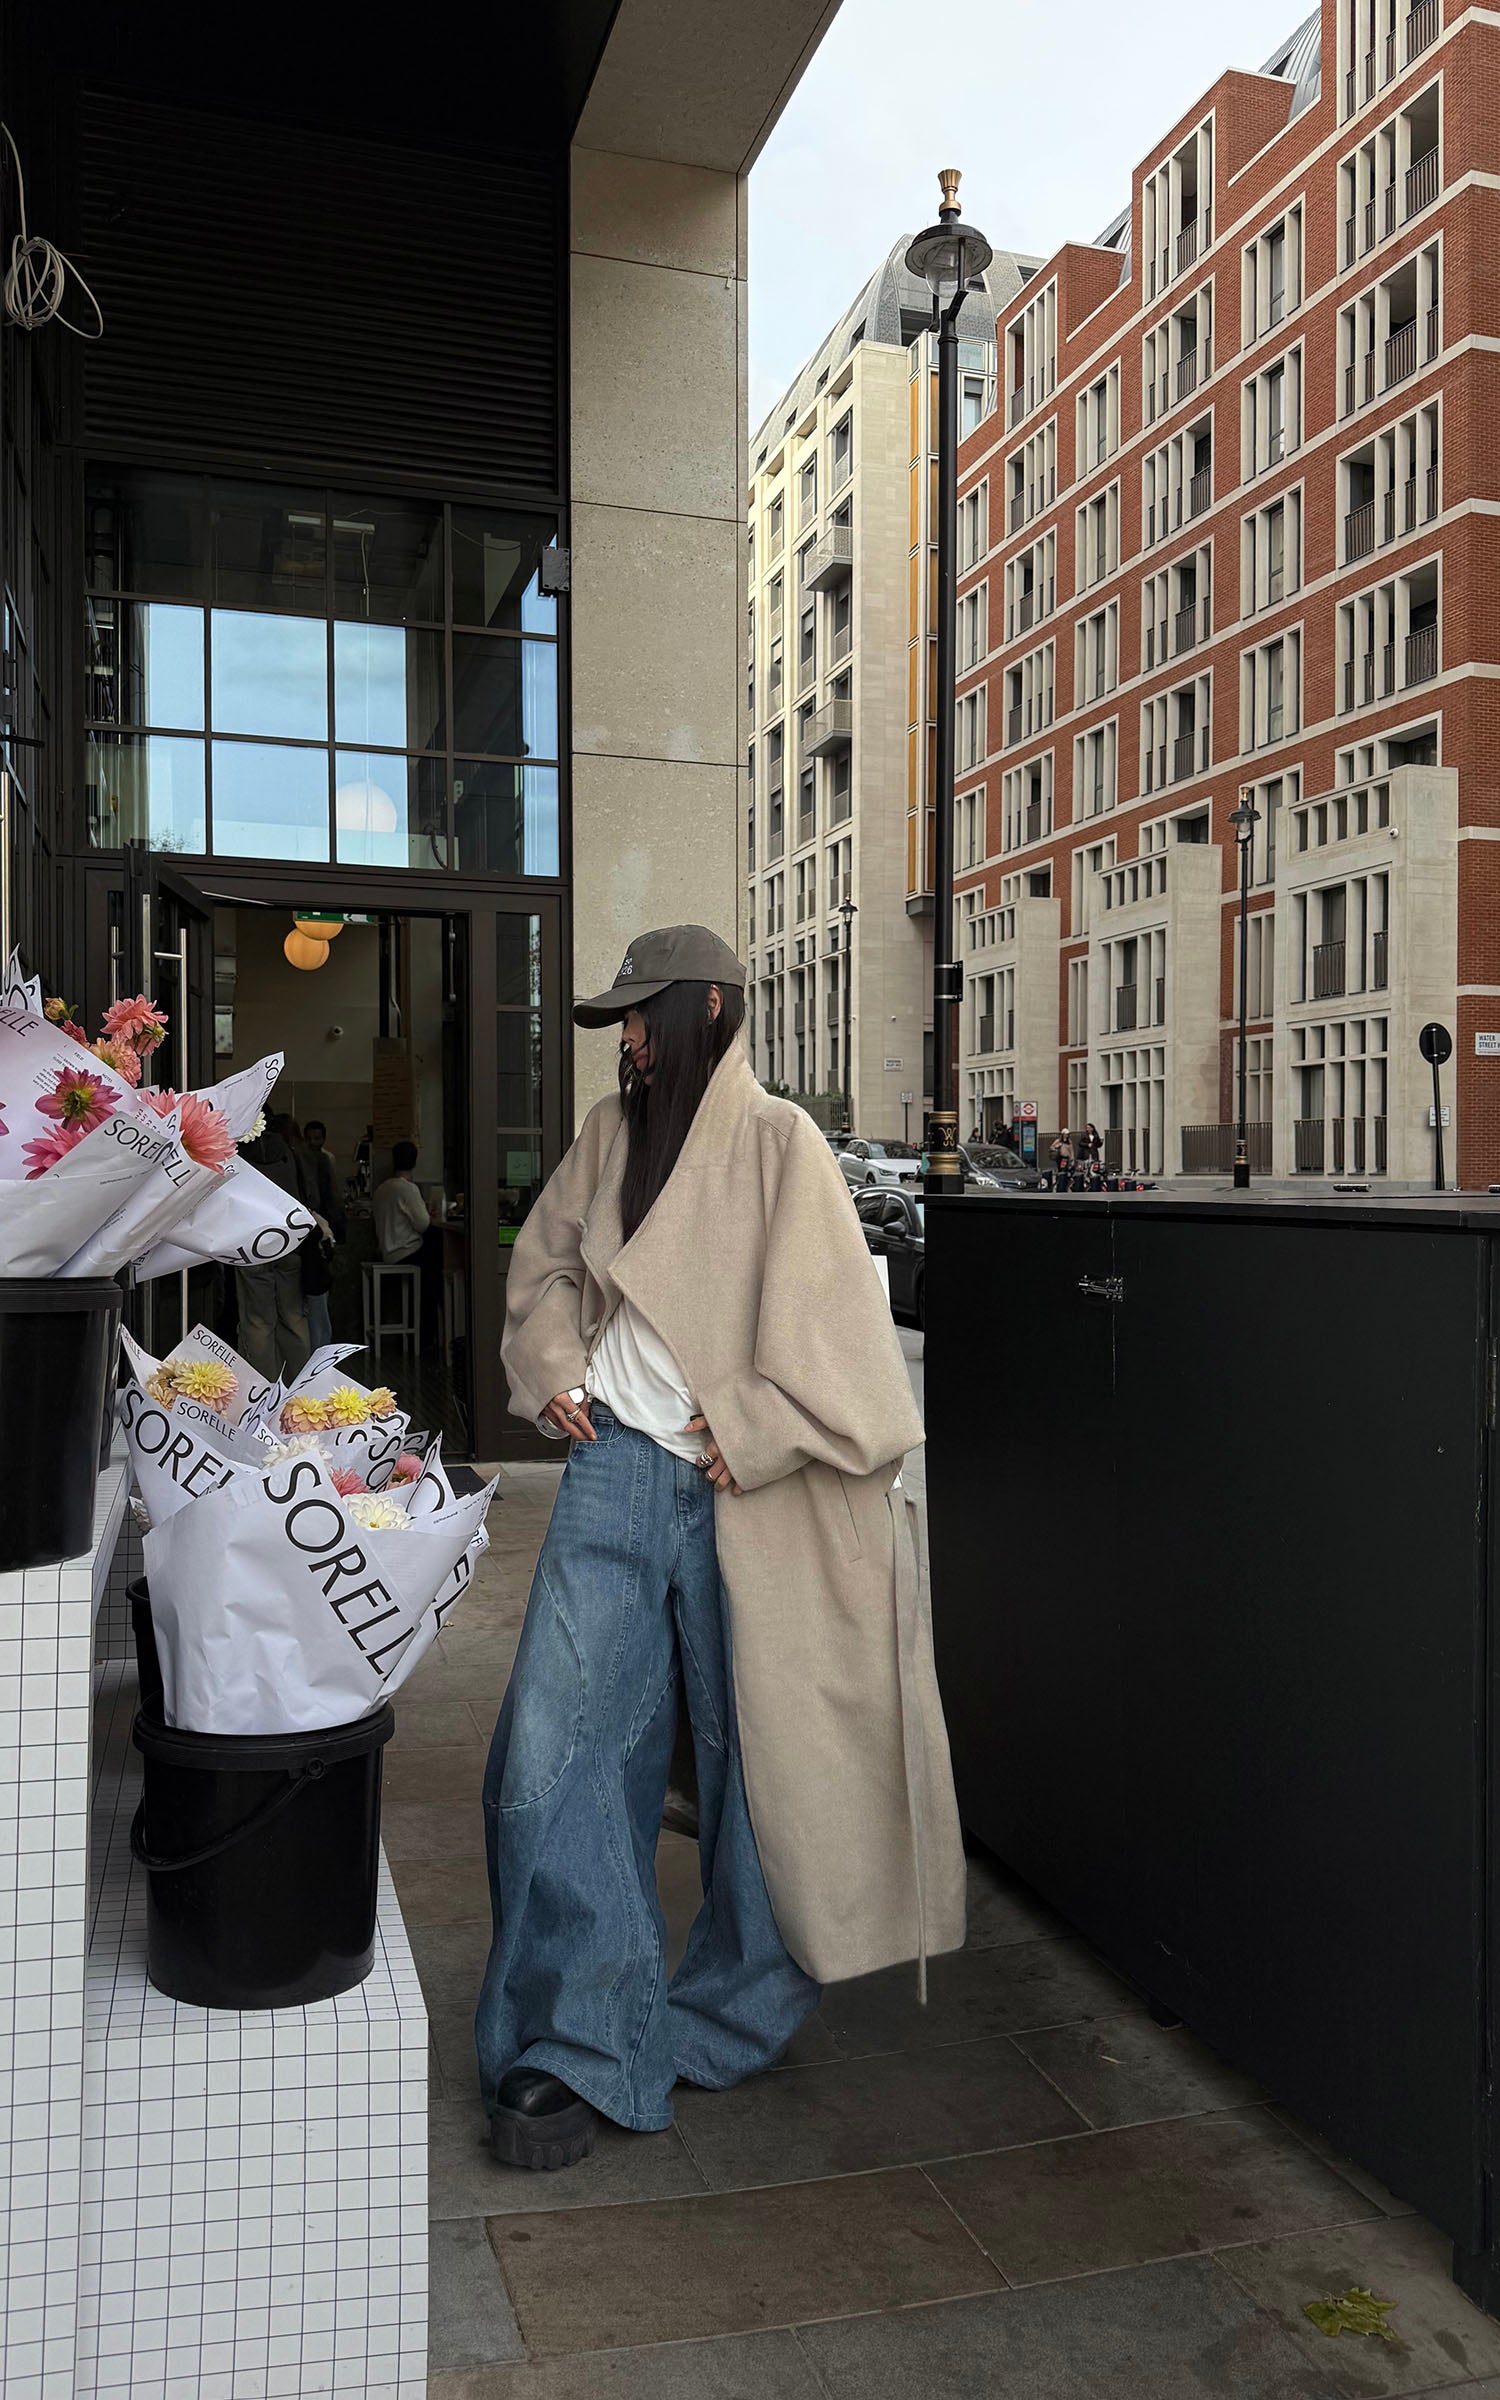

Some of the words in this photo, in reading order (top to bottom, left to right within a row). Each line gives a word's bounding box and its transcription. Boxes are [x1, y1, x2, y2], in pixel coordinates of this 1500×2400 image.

[193, 1329, 237, 1368] SORELLE
[177, 1401, 236, 1442] SORELLE
[262, 1461, 414, 1682] SORELL
